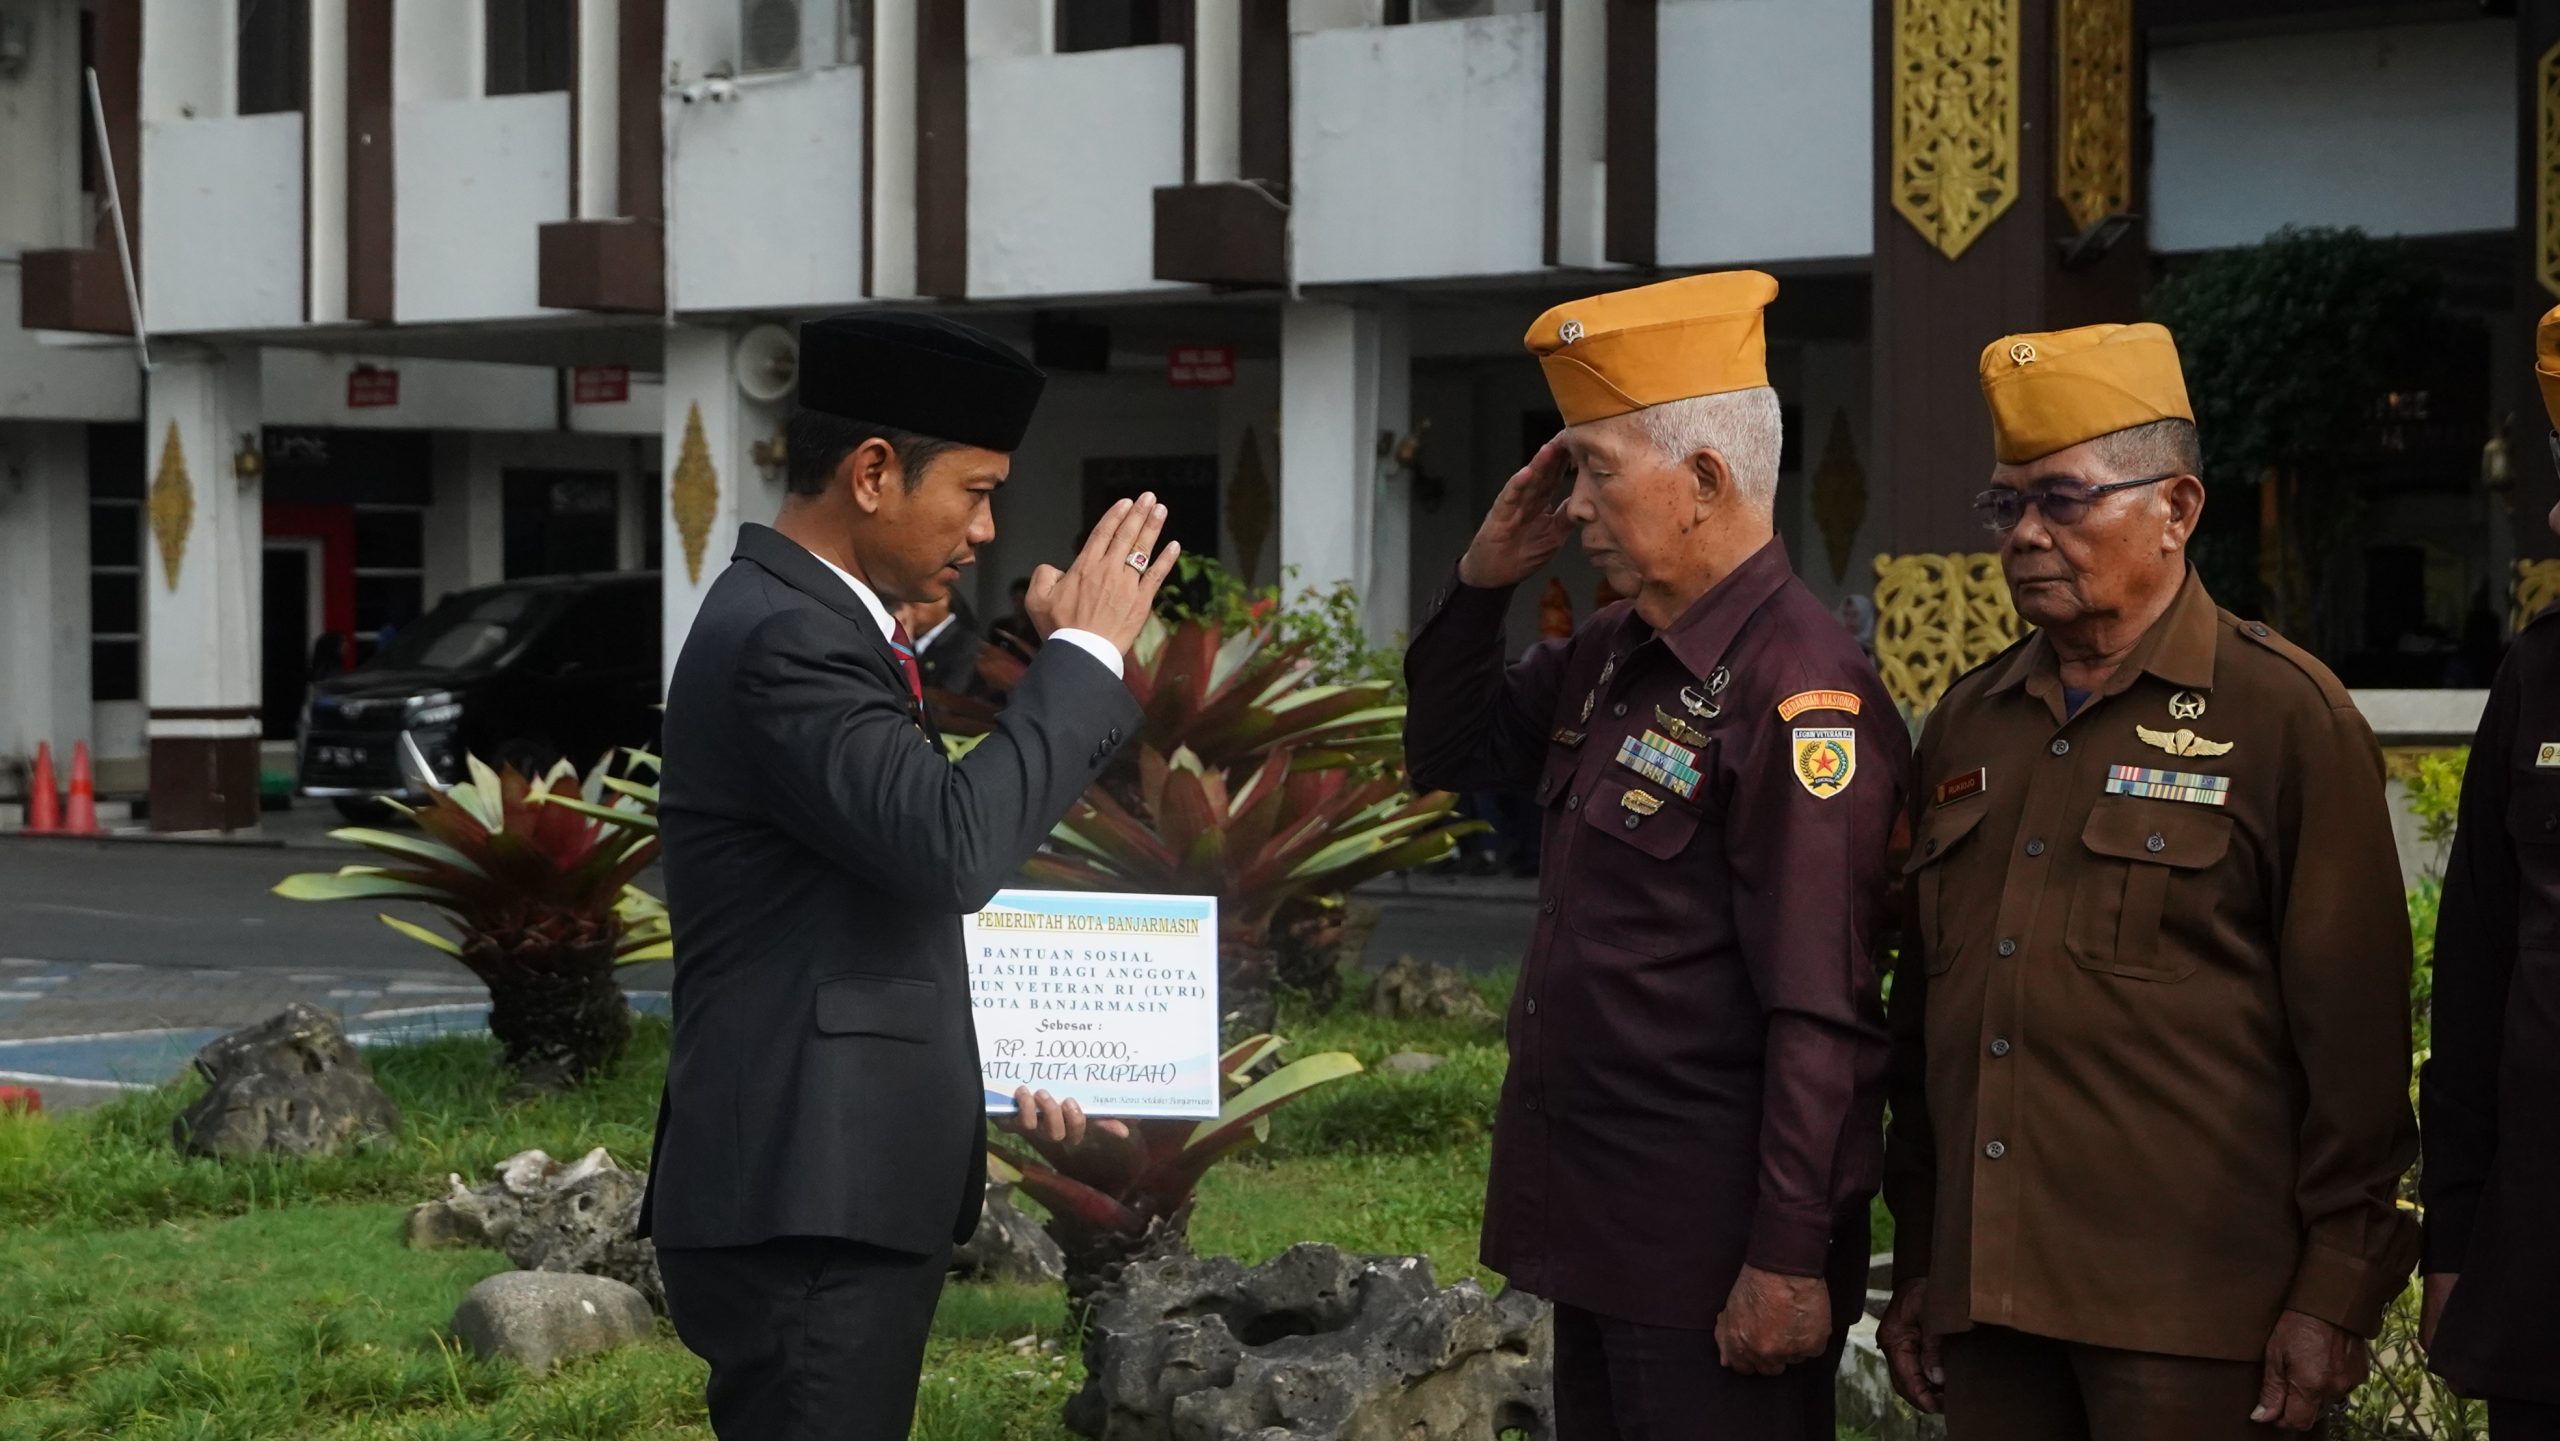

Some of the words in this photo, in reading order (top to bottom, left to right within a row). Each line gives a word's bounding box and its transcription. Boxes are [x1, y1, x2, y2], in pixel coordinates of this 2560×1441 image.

[977, 911, 1063, 930] PEMERINTAH
[1067, 914, 1104, 931] KOTA
[1108, 916, 1199, 934] BANJARMASIN
[983, 947, 1074, 960] BANTUAN
[1084, 950, 1153, 963] SOSIAL
[993, 964, 1039, 976] ASIH
[1050, 966, 1096, 978] BAGI
[1106, 967, 1197, 981] ANGGOTA
[971, 980, 1004, 992] IUN
[1015, 981, 1105, 995] VETERAN
[1115, 984, 1135, 996] RI
[1144, 985, 1206, 999] (LVRI)
[971, 997, 1020, 1009] KOTA
[1030, 998, 1169, 1013] BANJARMASIN
[1035, 1018, 1093, 1032] Sebesar
[994, 1038, 1027, 1058] RP.
[1034, 1039, 1139, 1061] 1.000.000,-
[981, 1061, 1021, 1080] ATU
[1022, 1062, 1078, 1084] JUTA
[1084, 1062, 1177, 1085] RUPIAH)
